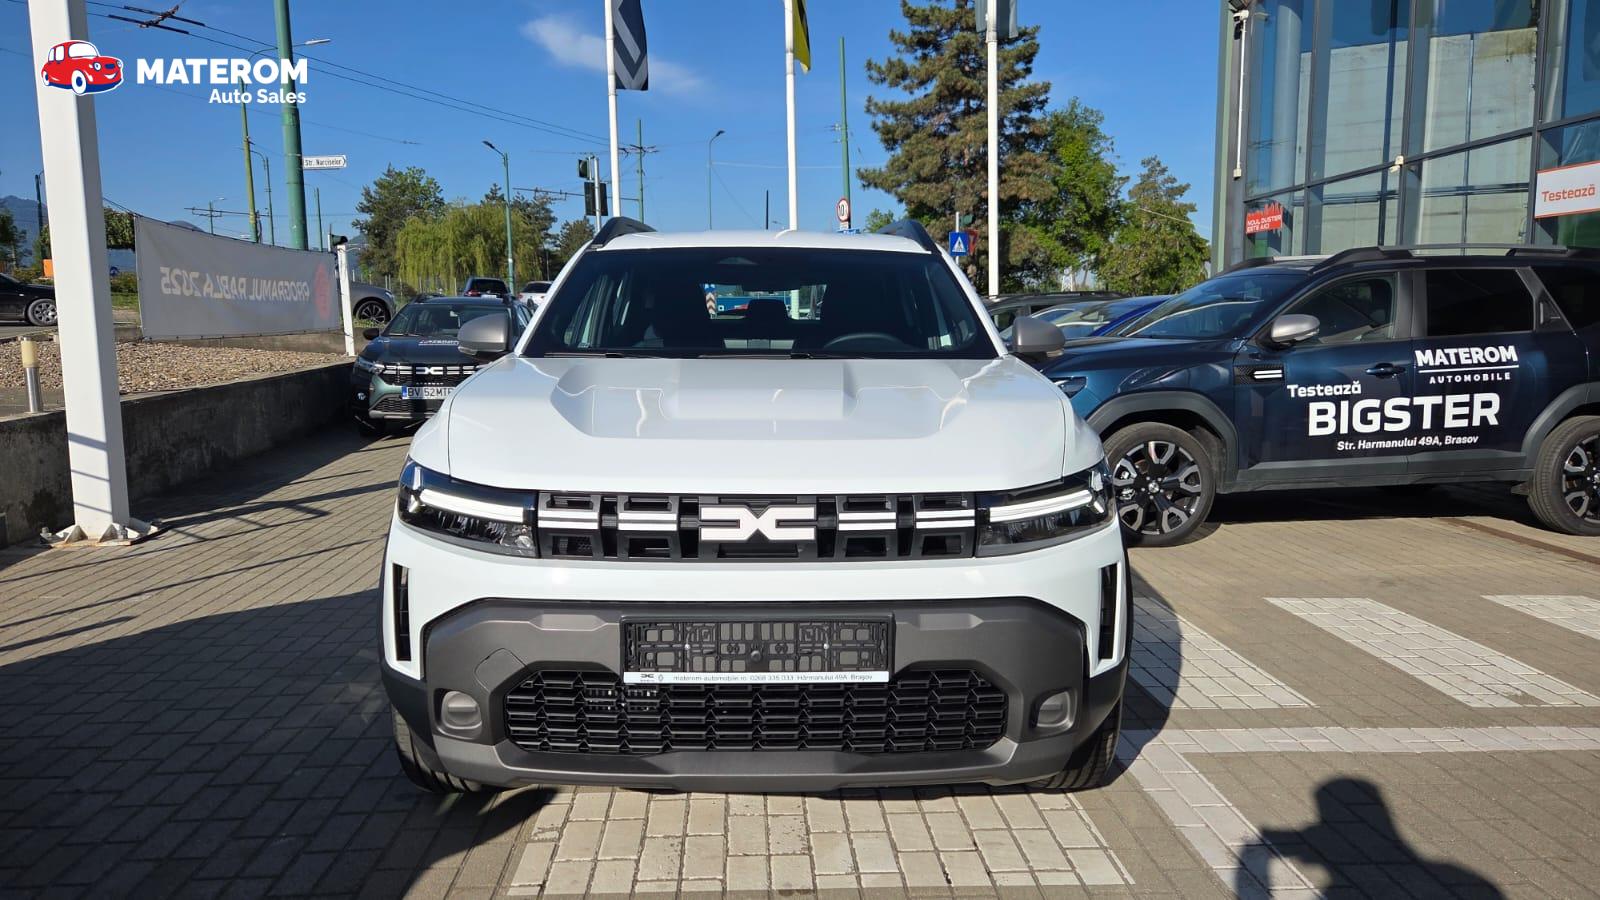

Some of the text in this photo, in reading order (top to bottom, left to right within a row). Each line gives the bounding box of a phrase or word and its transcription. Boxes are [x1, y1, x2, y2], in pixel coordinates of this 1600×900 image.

[1541, 184, 1596, 202] Testează
[1414, 345, 1519, 367] MATEROM
[1429, 371, 1511, 384] AUTOMOBILE
[408, 388, 421, 397] BV
[1287, 381, 1362, 398] Testează
[1308, 392, 1501, 437] BIGSTER
[1337, 434, 1479, 450] Str. Harmanului 49A, Brasov
